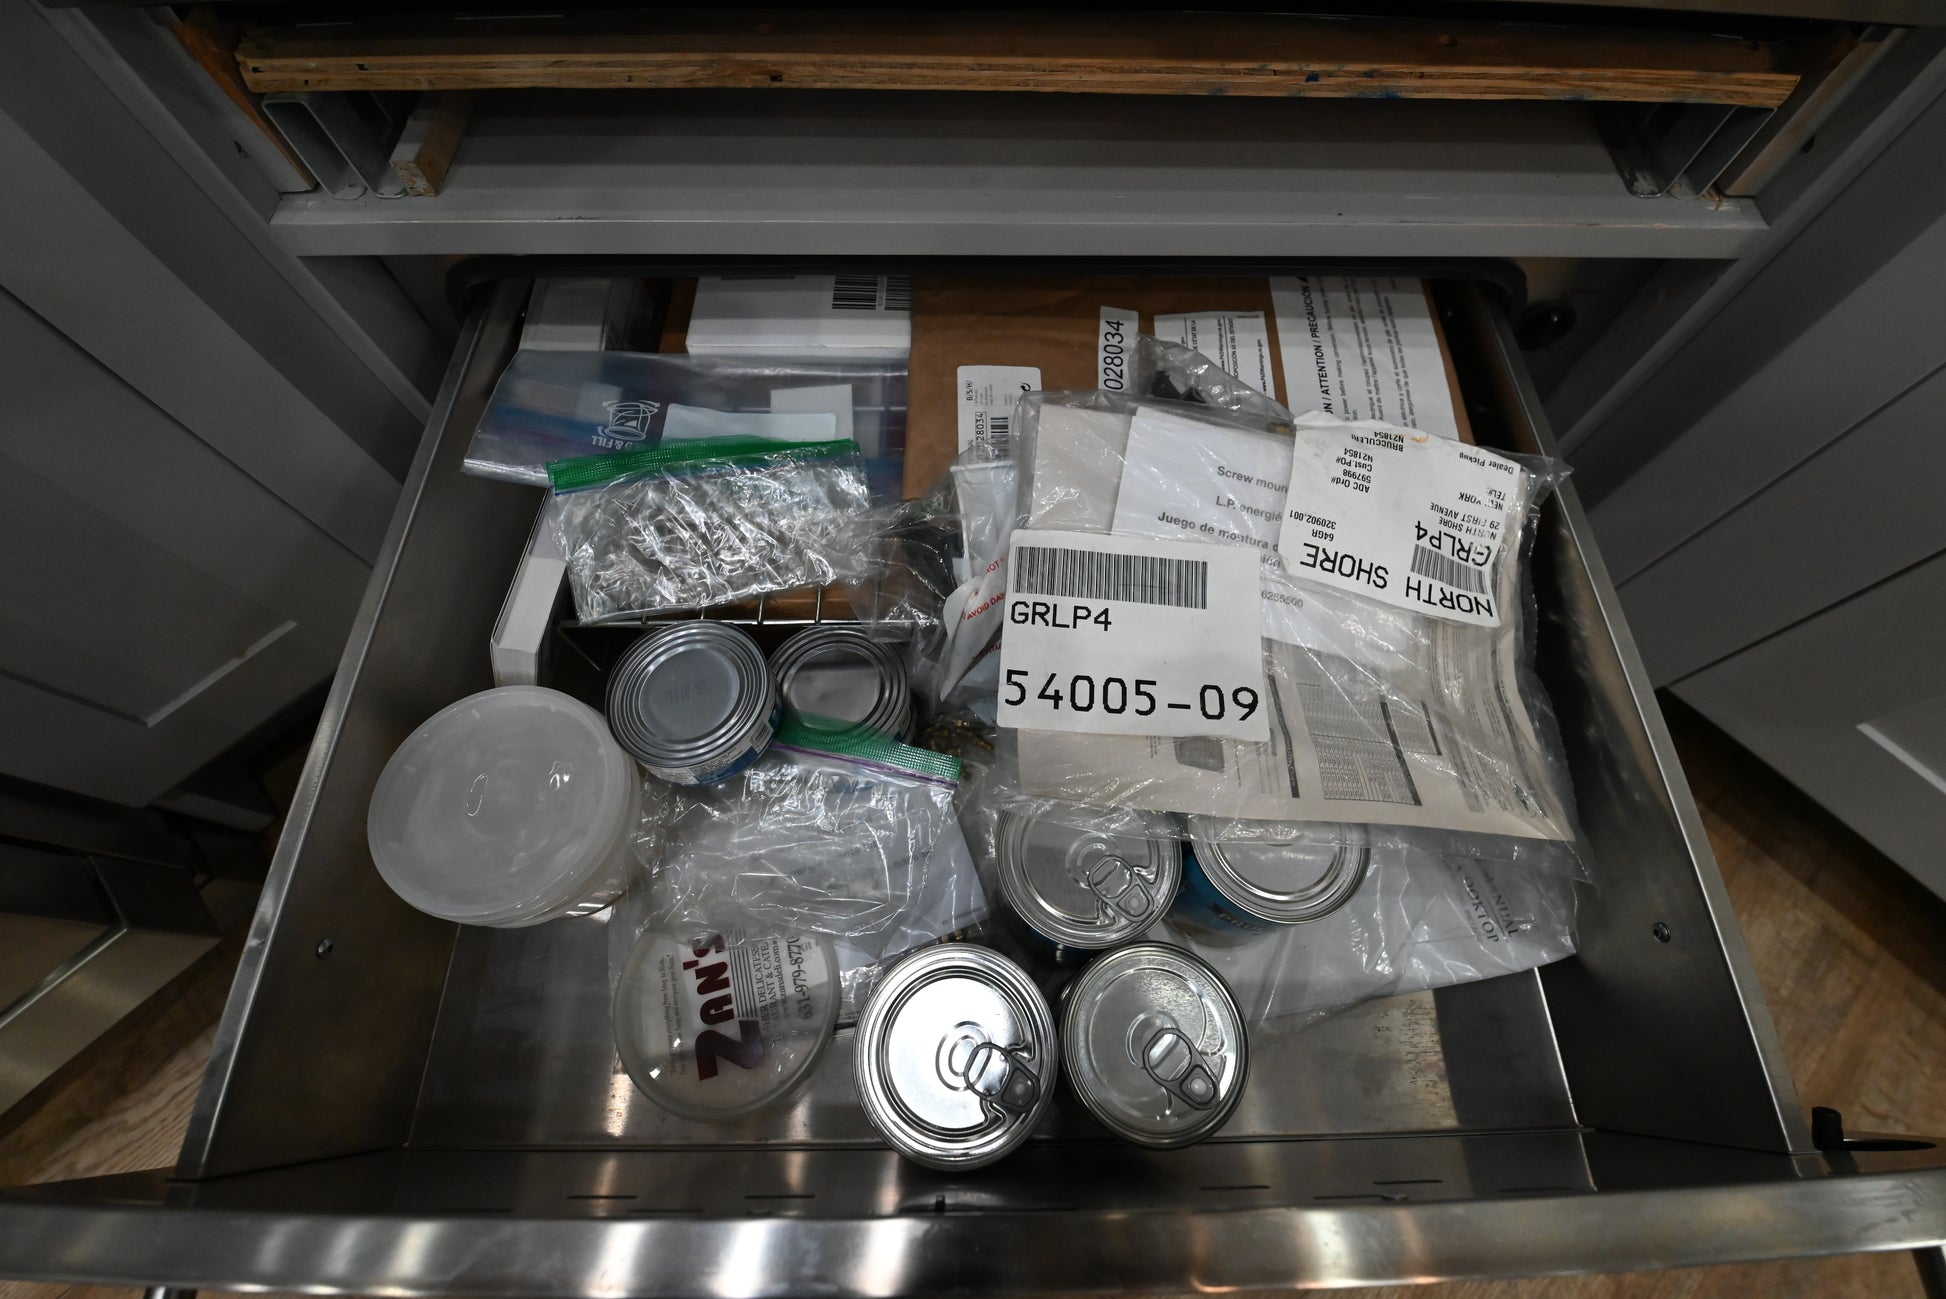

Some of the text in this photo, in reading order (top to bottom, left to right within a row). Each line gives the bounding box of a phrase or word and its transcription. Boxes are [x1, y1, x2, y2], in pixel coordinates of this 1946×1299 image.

[1103, 320, 1124, 390] 028034
[1314, 345, 1332, 396] ATTENTION
[976, 413, 985, 440] 28034
[1374, 431, 1404, 444] N21854
[592, 436, 614, 449] FILL
[1336, 456, 1373, 472] Cust.PO#
[1344, 448, 1374, 462] N21854
[1460, 452, 1514, 474] Dealer Pickup
[1217, 466, 1288, 494] Screw moun
[1330, 476, 1370, 494] ADC Ord#
[1342, 468, 1372, 484] 597998
[1216, 496, 1283, 522] L.P. energié
[1289, 510, 1337, 530] 320902.001
[1430, 502, 1460, 520] AVENUE
[1158, 512, 1196, 530] Juego
[1200, 522, 1214, 534] de
[1218, 530, 1268, 550] montura
[1312, 528, 1334, 542] 64GR
[1438, 516, 1464, 532] SHORE
[1490, 520, 1500, 530] 29
[1414, 520, 1492, 567] GRLP4
[1300, 542, 1494, 618] NORTH SHORE
[966, 602, 990, 620] AVOID
[1010, 600, 1112, 632] GRLP4
[1004, 668, 1260, 722] 54005-09
[760, 940, 772, 970] CATE
[751, 944, 768, 1004] DELICATESS
